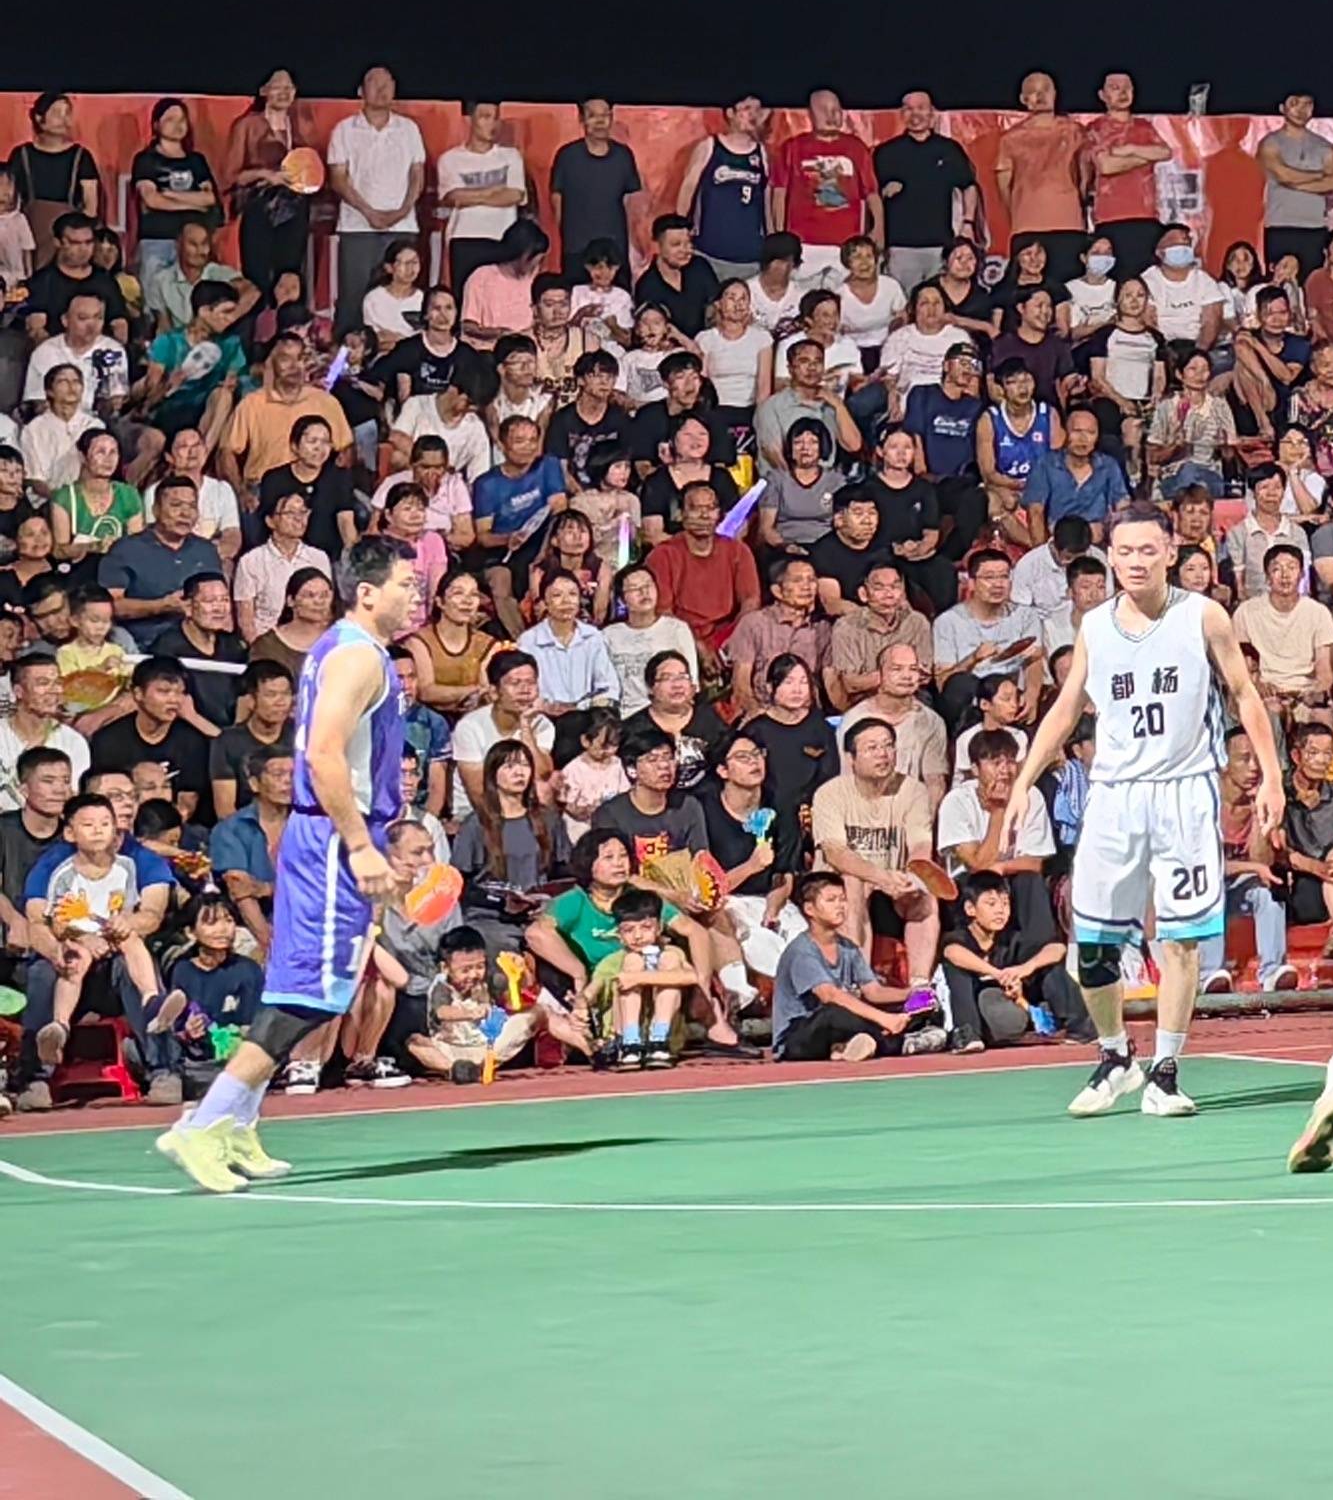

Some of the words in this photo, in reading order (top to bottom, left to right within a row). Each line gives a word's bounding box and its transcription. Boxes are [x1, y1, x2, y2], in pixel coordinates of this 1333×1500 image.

[1110, 665, 1180, 701] 都杨
[1130, 702, 1165, 739] 20
[1171, 864, 1210, 901] 20
